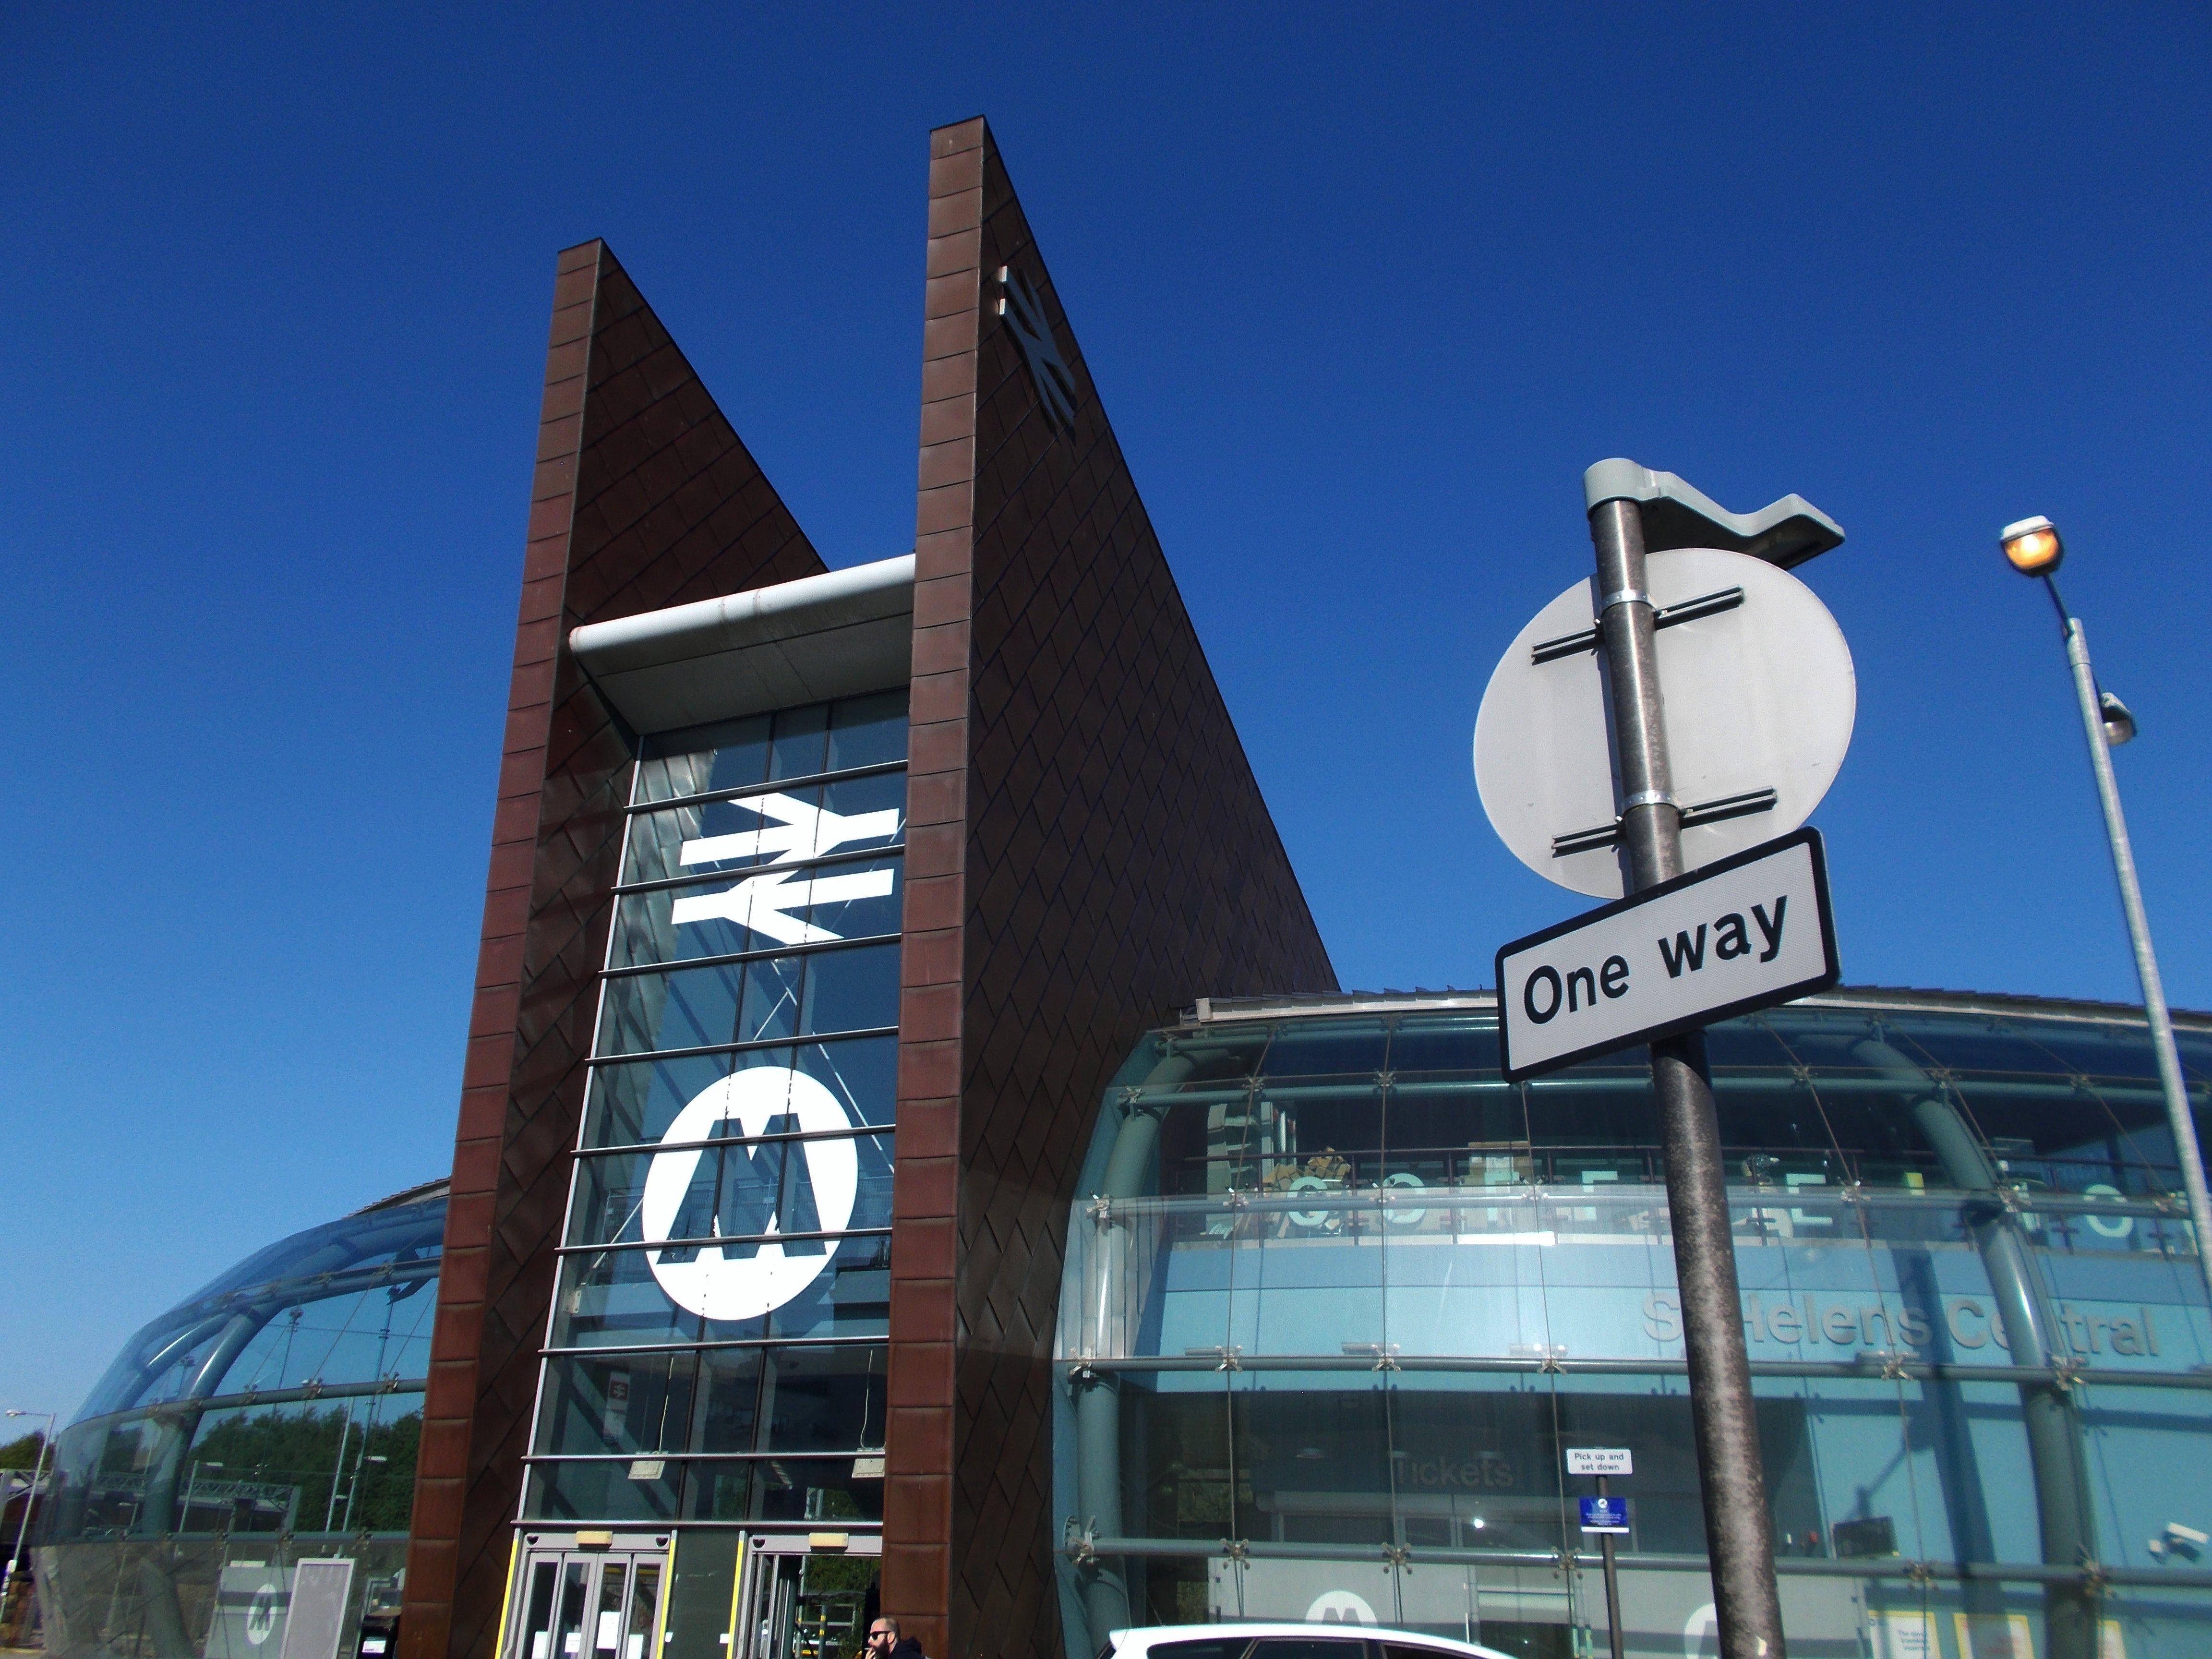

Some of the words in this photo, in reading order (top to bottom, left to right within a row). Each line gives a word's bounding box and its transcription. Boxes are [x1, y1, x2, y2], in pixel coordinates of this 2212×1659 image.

[1524, 954, 1630, 1024] One
[1658, 895, 1788, 979] way
[1286, 1170, 1833, 1226] COFFE
[1947, 1298, 2159, 1357] Ctral
[1394, 1456, 1514, 1487] Tickets
